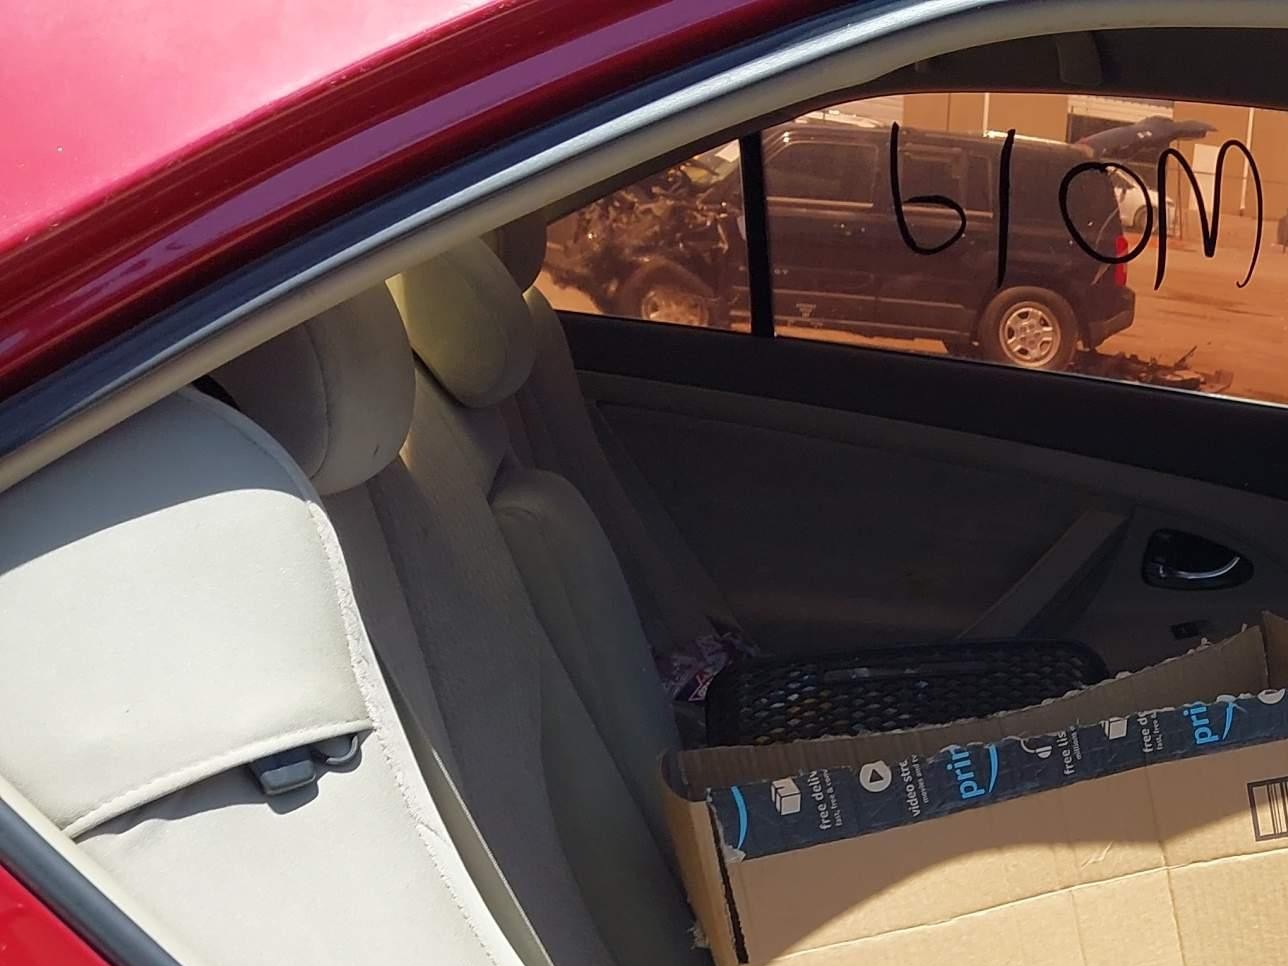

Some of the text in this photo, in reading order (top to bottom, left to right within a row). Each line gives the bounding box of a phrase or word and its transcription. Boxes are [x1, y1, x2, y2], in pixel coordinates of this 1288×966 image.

[1183, 703, 1220, 746] pri
[1142, 728, 1154, 753] free
[1063, 749, 1076, 775] free
[829, 794, 838, 810] free
[905, 784, 921, 817] video
[918, 778, 930, 804] movies
[819, 803, 832, 830] free
[833, 809, 843, 827] fast,
